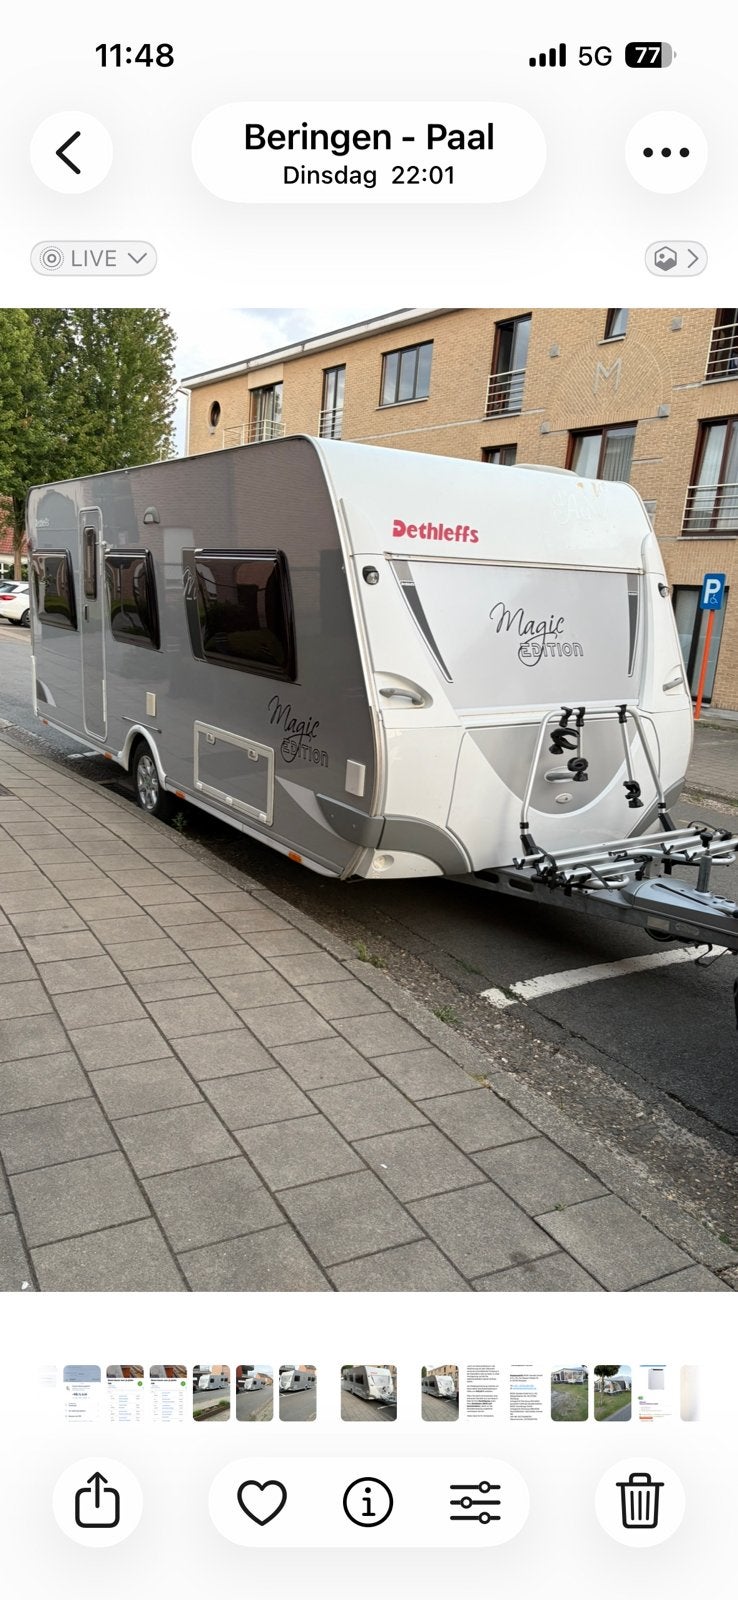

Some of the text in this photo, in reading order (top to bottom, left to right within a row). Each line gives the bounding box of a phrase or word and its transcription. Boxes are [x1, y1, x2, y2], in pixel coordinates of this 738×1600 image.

[592, 357, 623, 394] M
[392, 519, 479, 544] Dethleffs
[703, 578, 721, 604] P
[489, 601, 565, 667] Magic
[519, 642, 584, 658] EDITION
[267, 695, 320, 763] Magic
